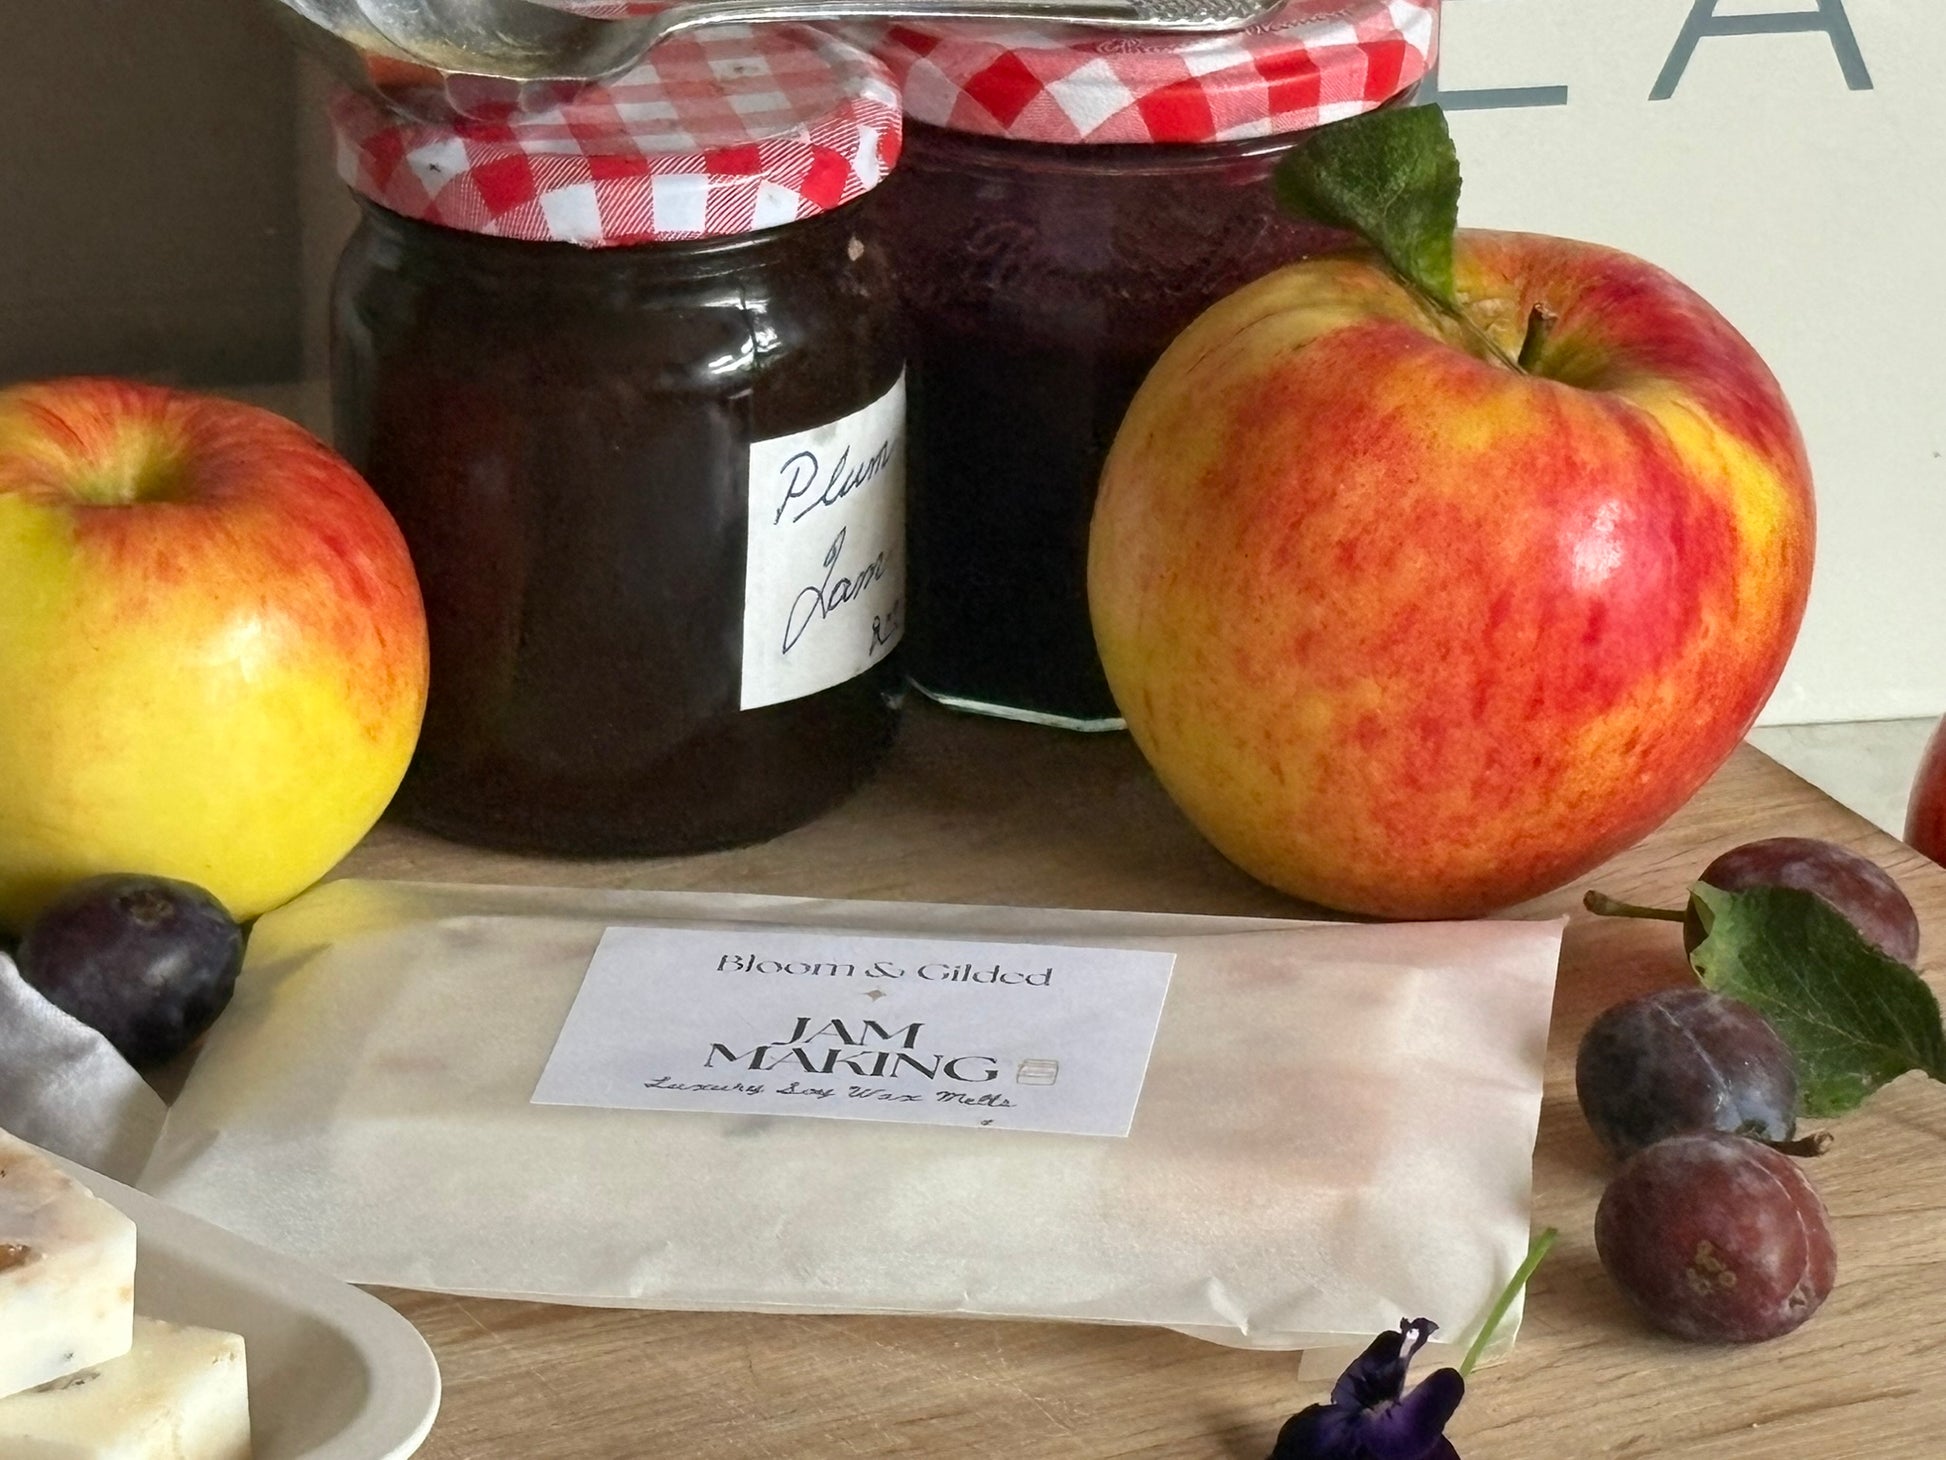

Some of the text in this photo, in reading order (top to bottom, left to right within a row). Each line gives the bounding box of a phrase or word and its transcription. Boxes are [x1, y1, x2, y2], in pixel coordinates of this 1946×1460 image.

[773, 440, 892, 526] Plum
[716, 954, 1054, 987] Bloom & Gilded
[771, 1017, 926, 1049] JAM
[703, 1043, 999, 1083] MAKING
[643, 1076, 1018, 1108] Luxury Soy Wax Melts
